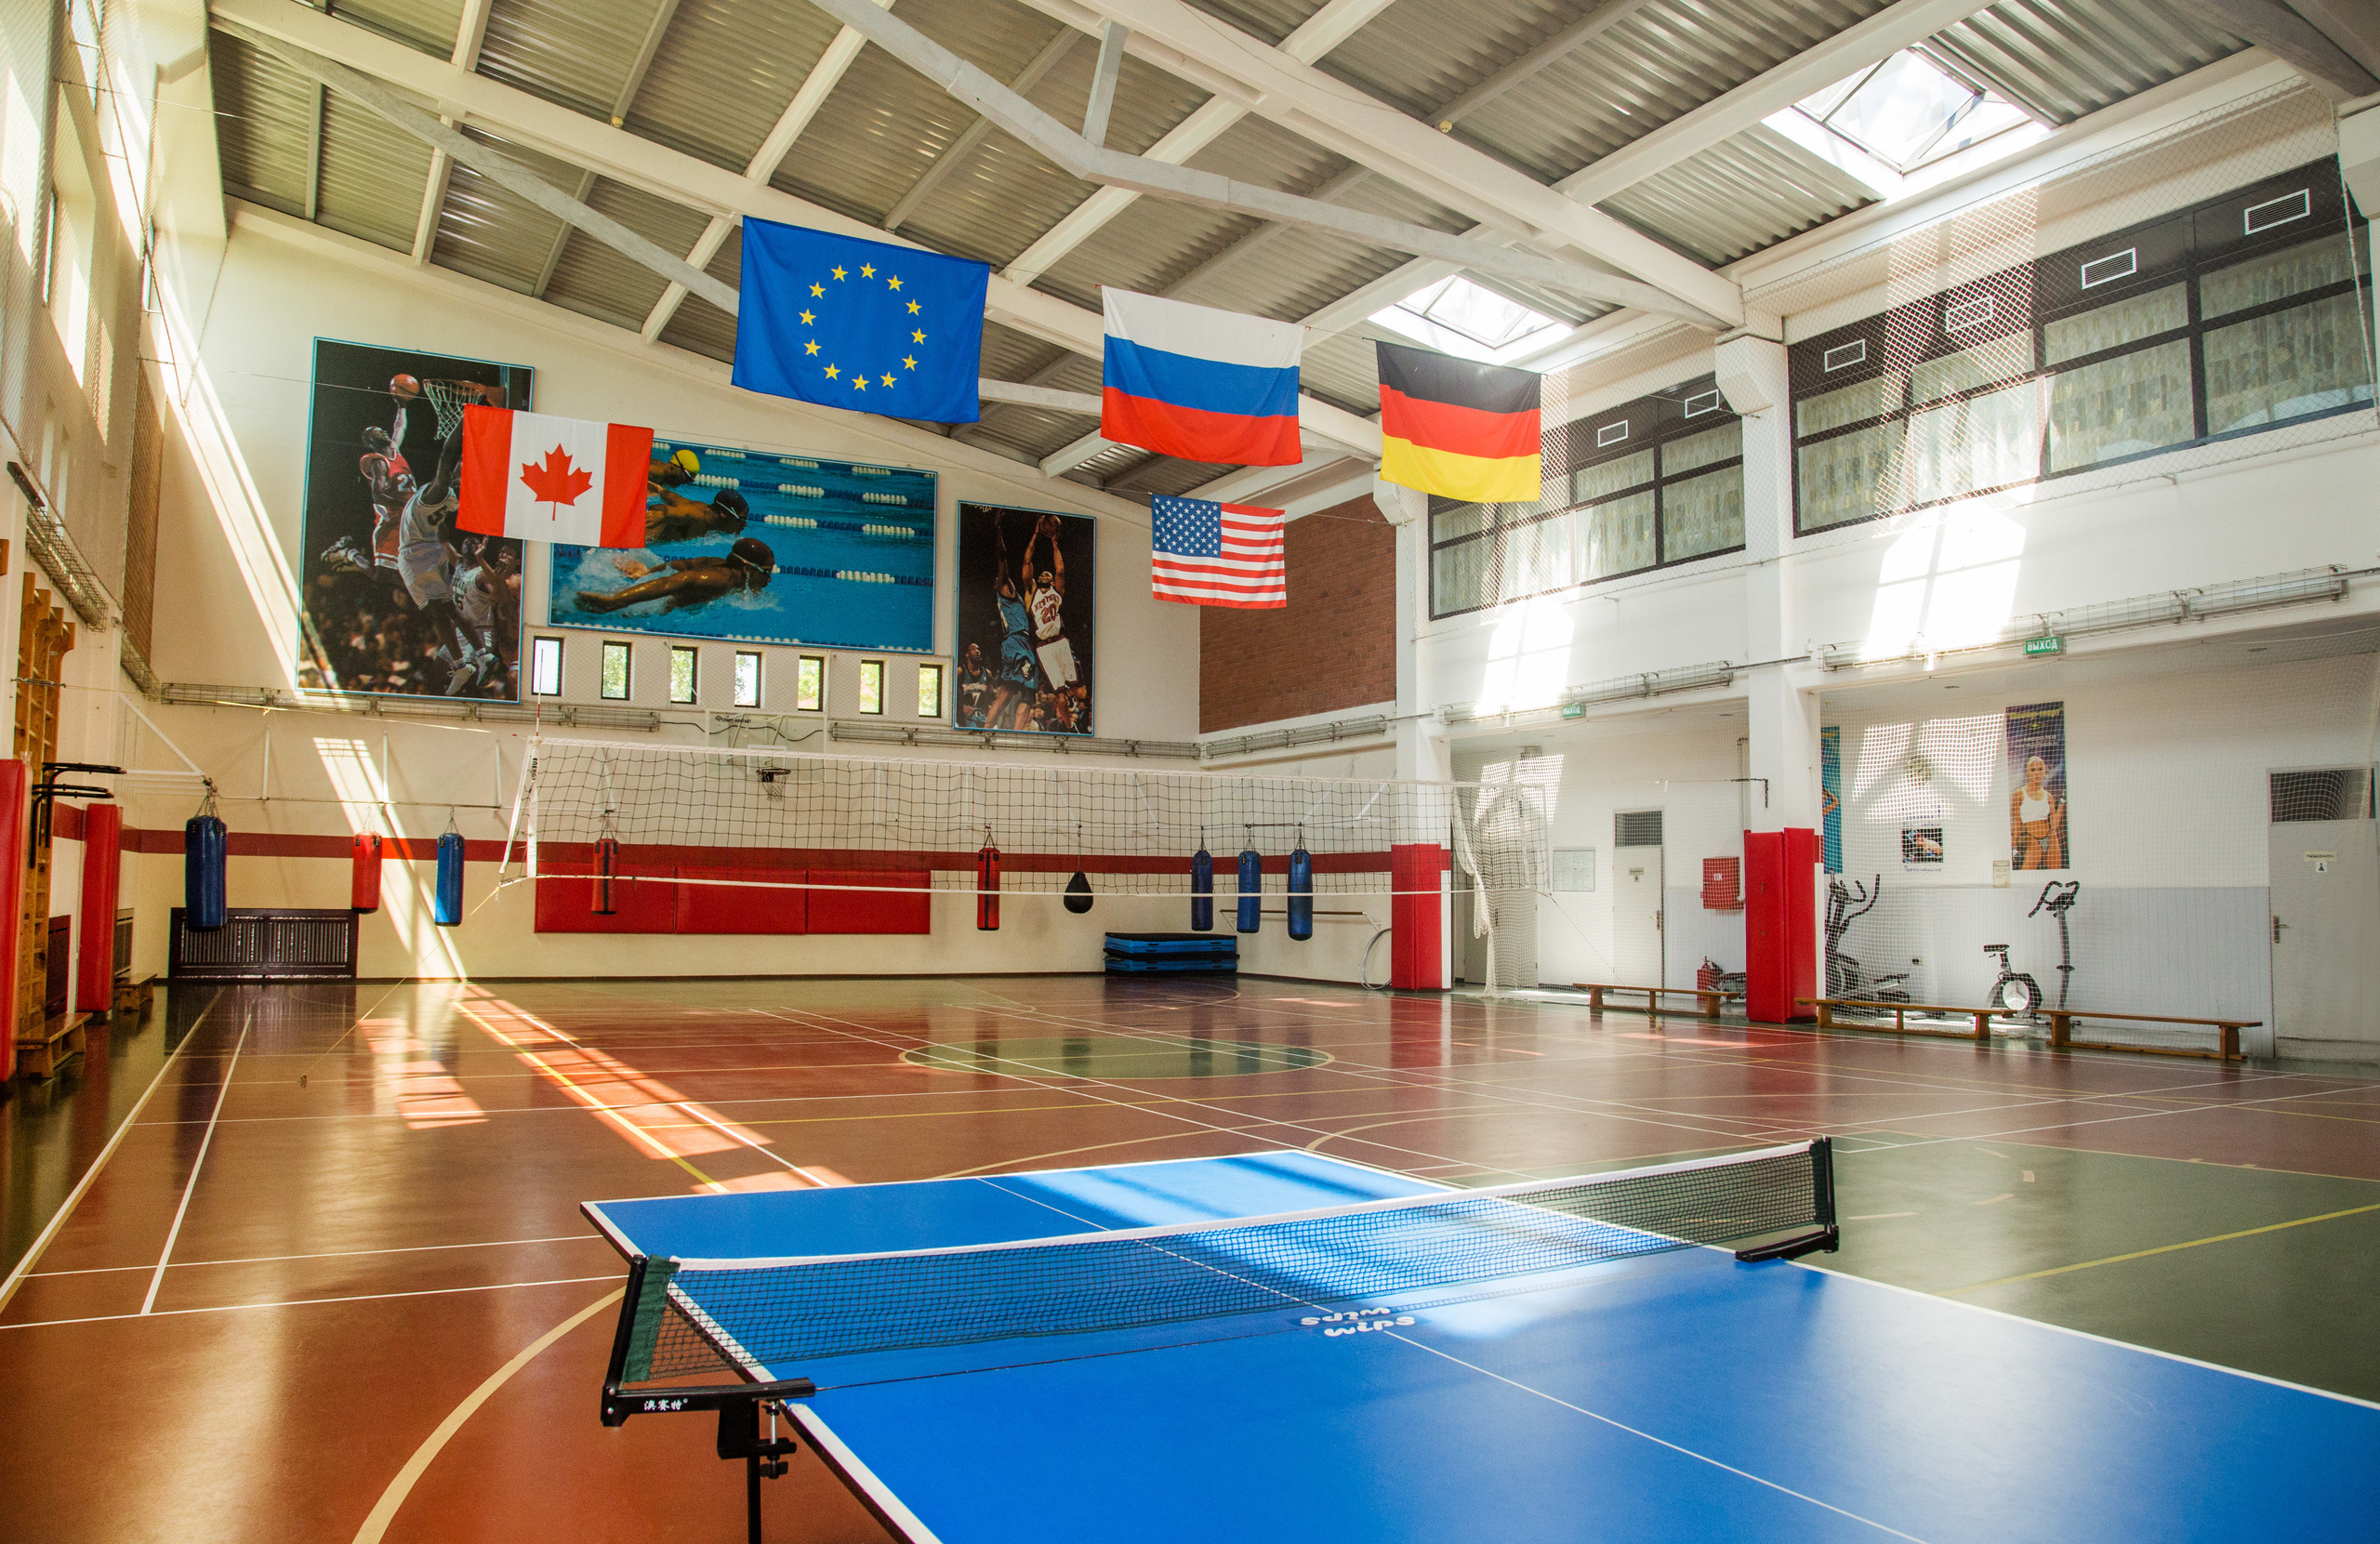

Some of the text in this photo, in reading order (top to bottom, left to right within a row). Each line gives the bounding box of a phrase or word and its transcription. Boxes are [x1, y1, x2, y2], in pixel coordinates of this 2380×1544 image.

[1040, 603, 1058, 625] 20
[2027, 639, 2058, 652] ВЫХОД
[972, 692, 982, 706] 7
